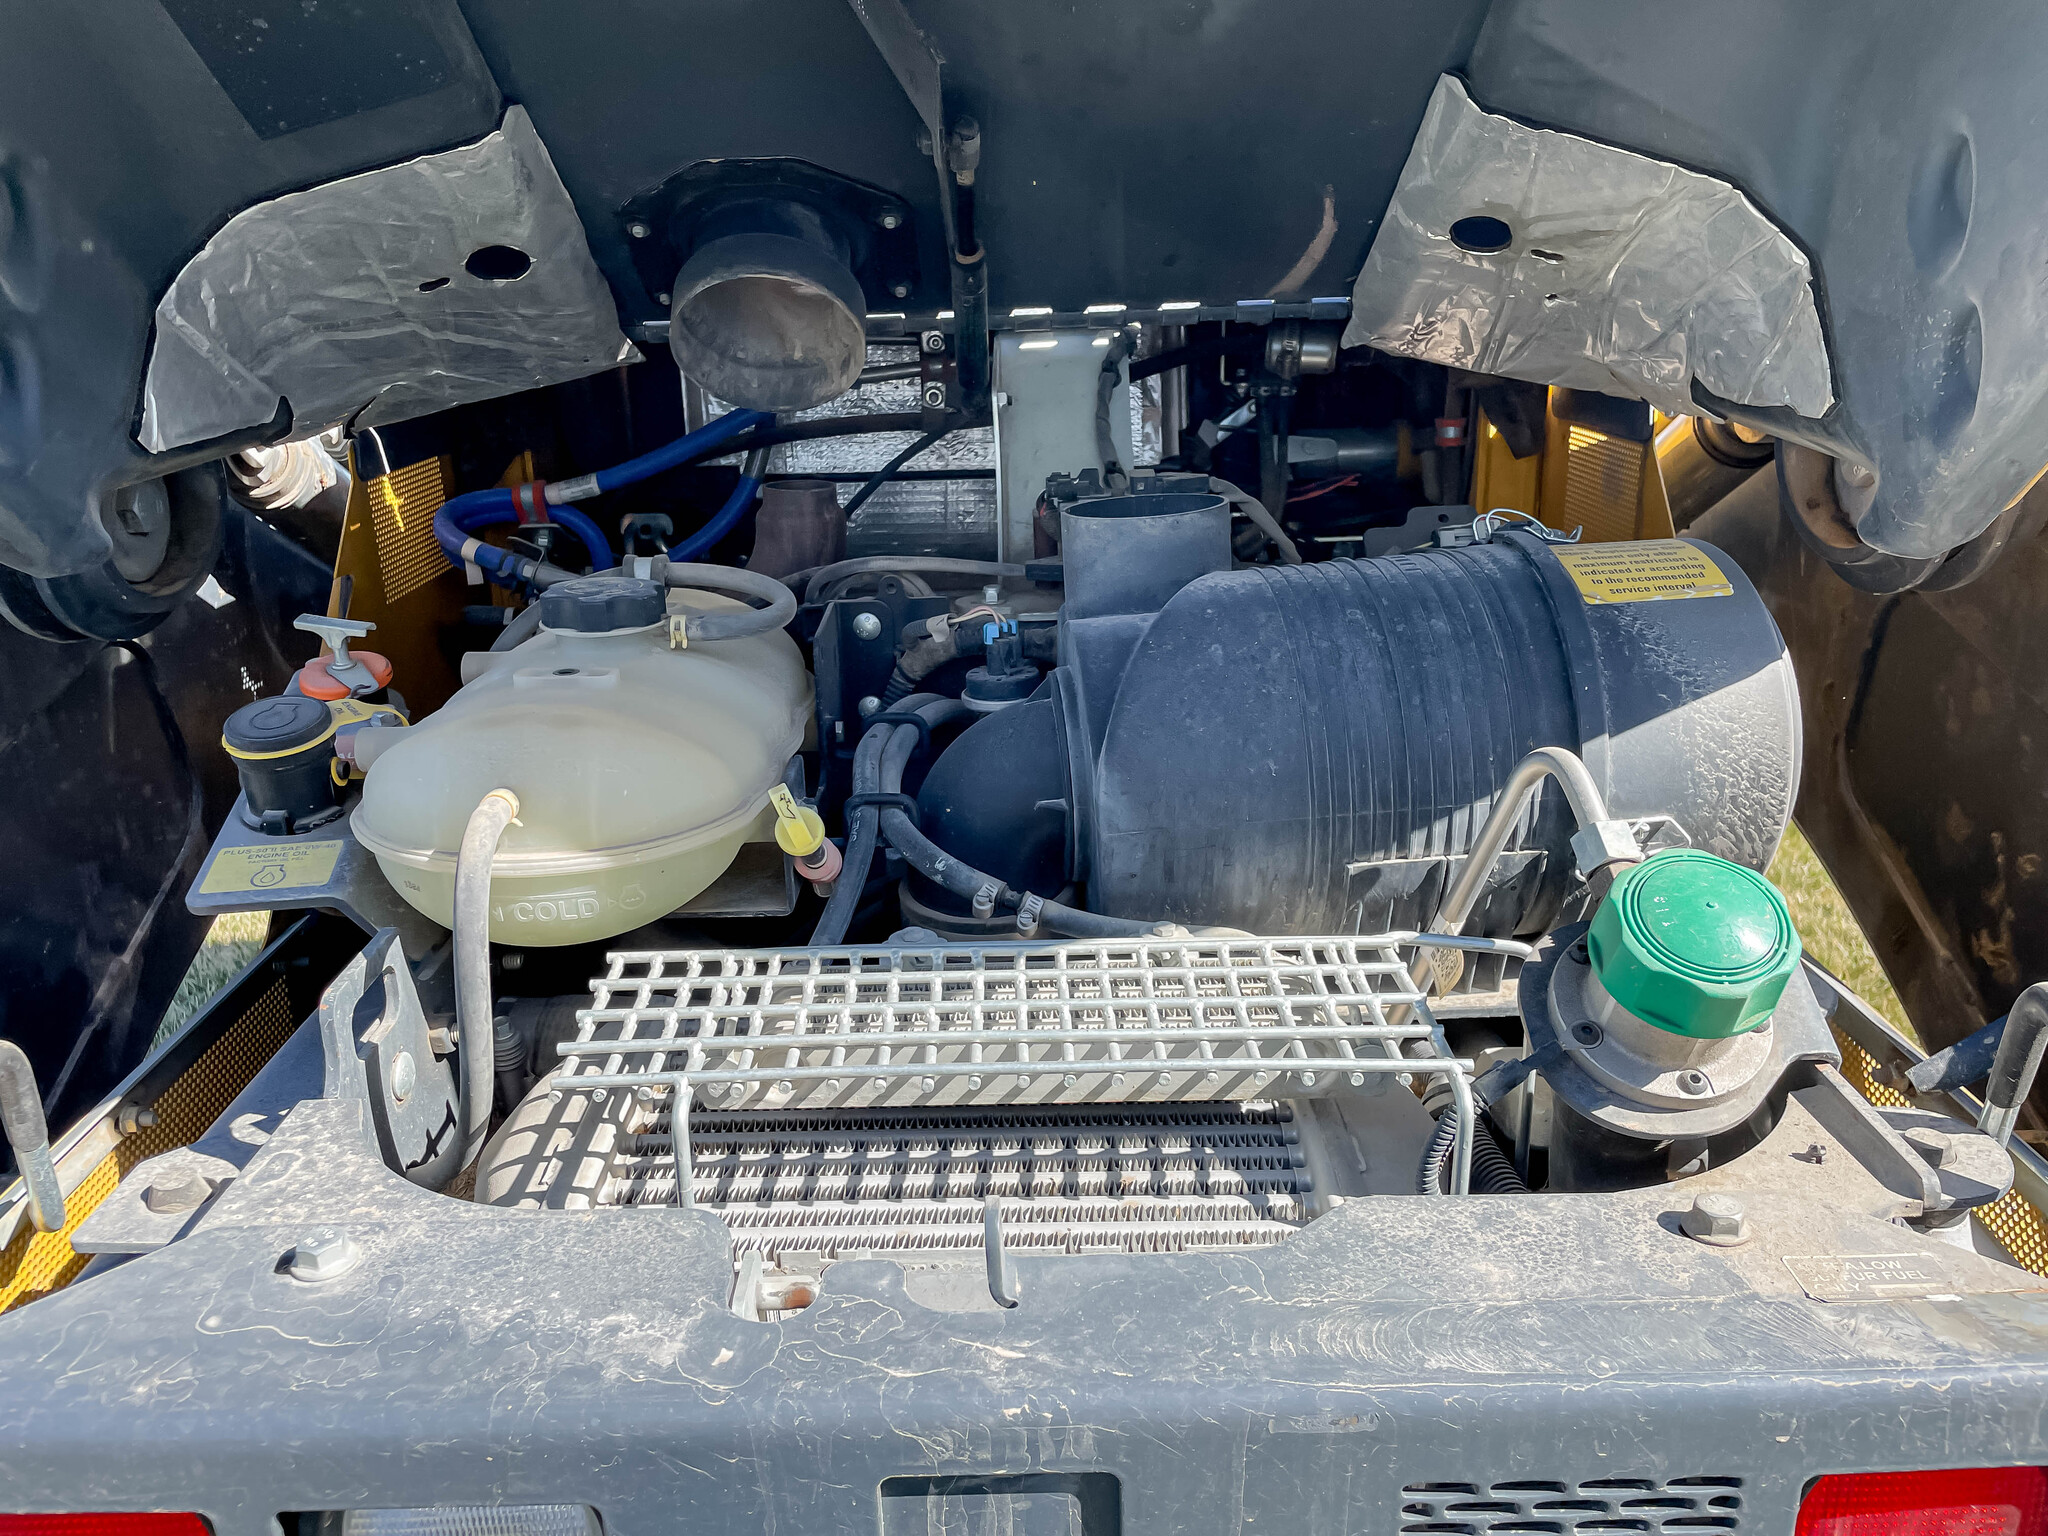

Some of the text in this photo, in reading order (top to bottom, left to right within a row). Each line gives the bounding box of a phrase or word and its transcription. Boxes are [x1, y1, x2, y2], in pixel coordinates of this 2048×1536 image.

[1629, 557, 1687, 565] restriction
[1579, 567, 1632, 576] indicated
[1649, 563, 1706, 572] according
[1626, 571, 1706, 583] recommended
[1609, 581, 1697, 594] service interval
[247, 852, 290, 860] ENGINE
[513, 897, 600, 923] COLD
[1859, 1260, 1902, 1270] LOW
[1881, 1270, 1932, 1280] FUEL
